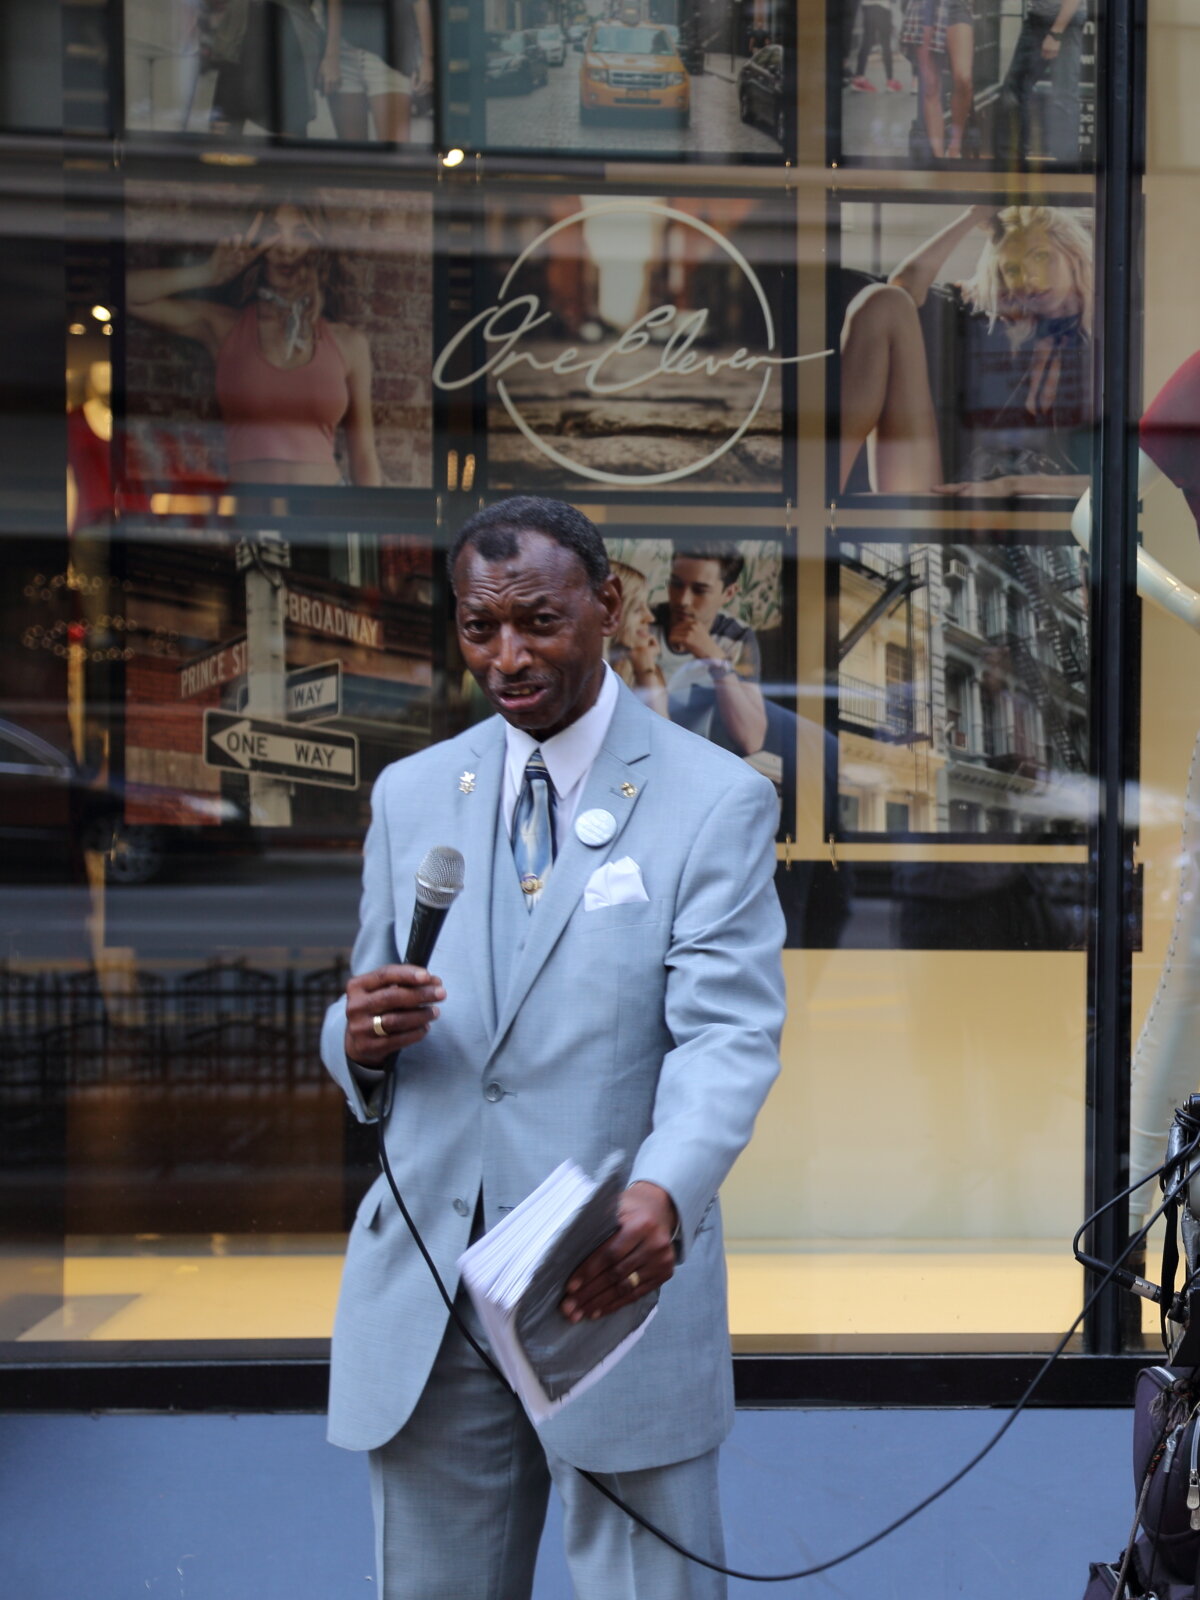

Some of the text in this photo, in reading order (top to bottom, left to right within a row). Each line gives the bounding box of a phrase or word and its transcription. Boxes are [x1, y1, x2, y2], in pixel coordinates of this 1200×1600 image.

[288, 593, 379, 648] BROADWAY
[181, 647, 226, 698] PRINCE
[293, 682, 324, 708] WAY
[226, 731, 336, 768] ONE WAY
